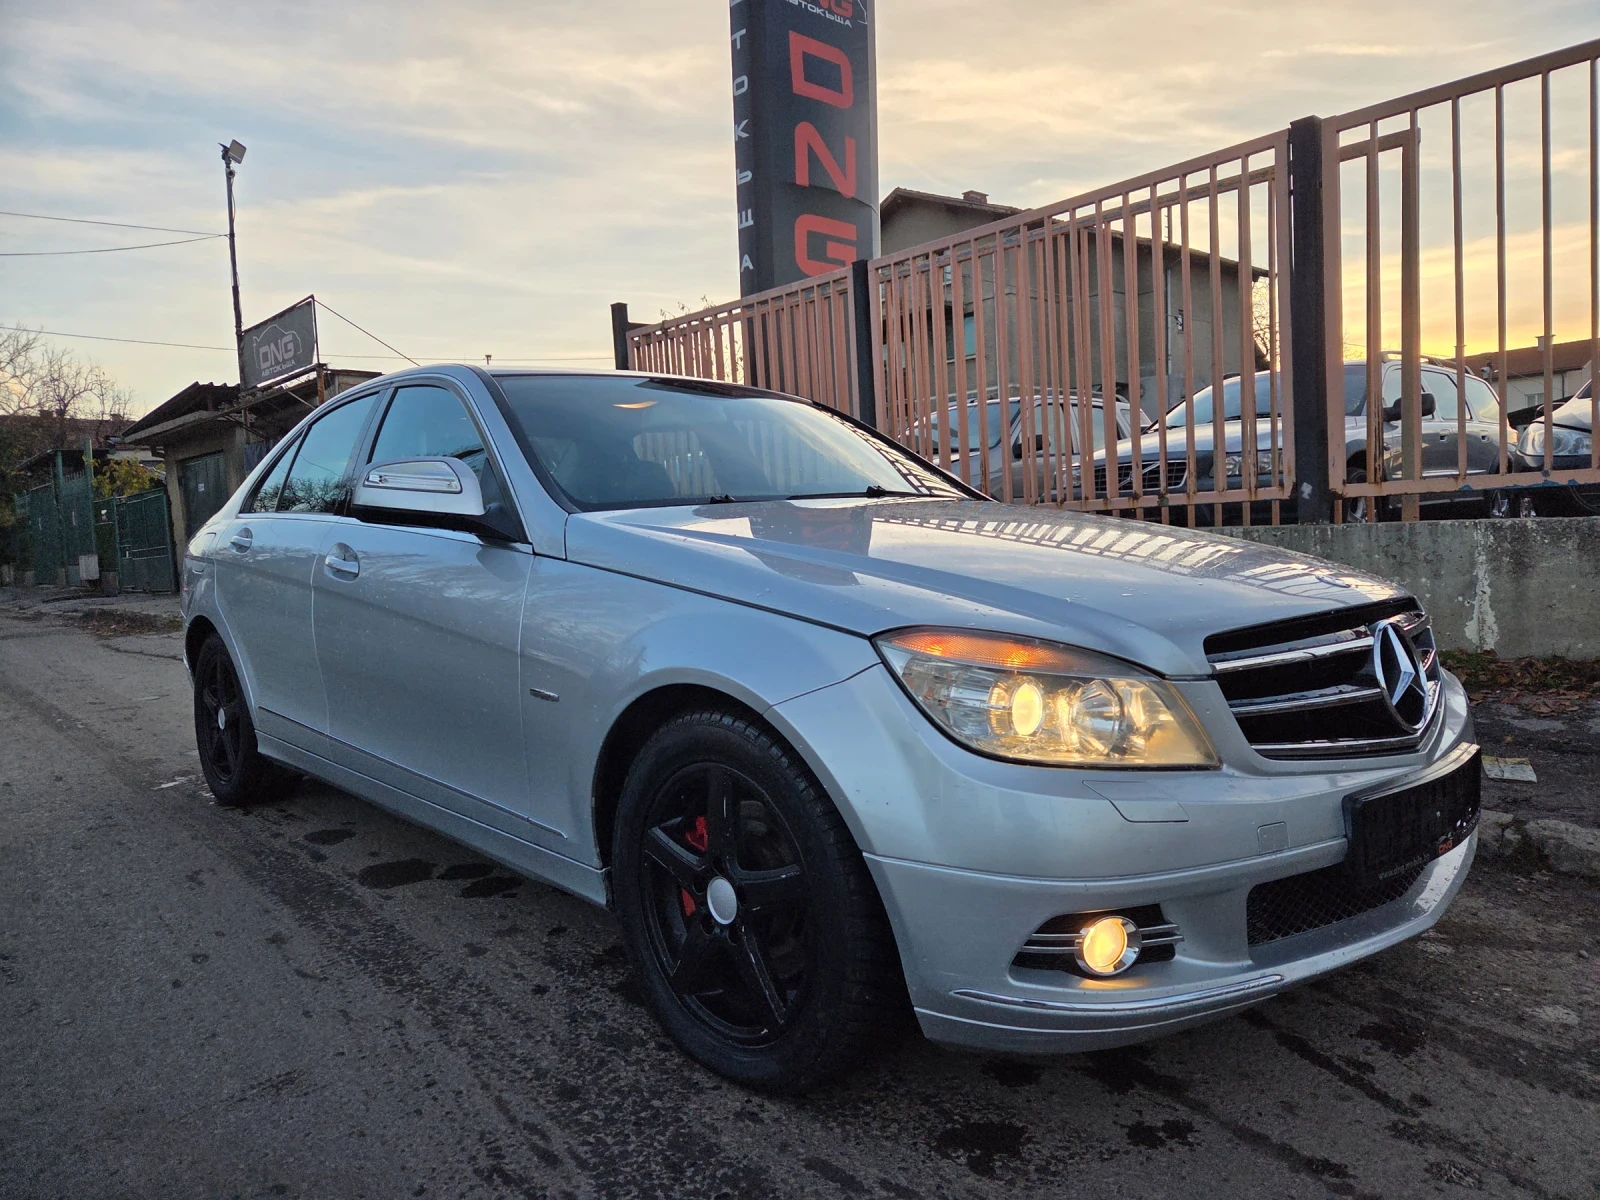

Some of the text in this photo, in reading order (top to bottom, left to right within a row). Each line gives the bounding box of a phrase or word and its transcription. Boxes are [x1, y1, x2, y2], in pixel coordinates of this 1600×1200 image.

[786, 0, 852, 28] ВТОКЪЩА
[789, 30, 857, 278] DNG
[259, 334, 294, 370] DNG
